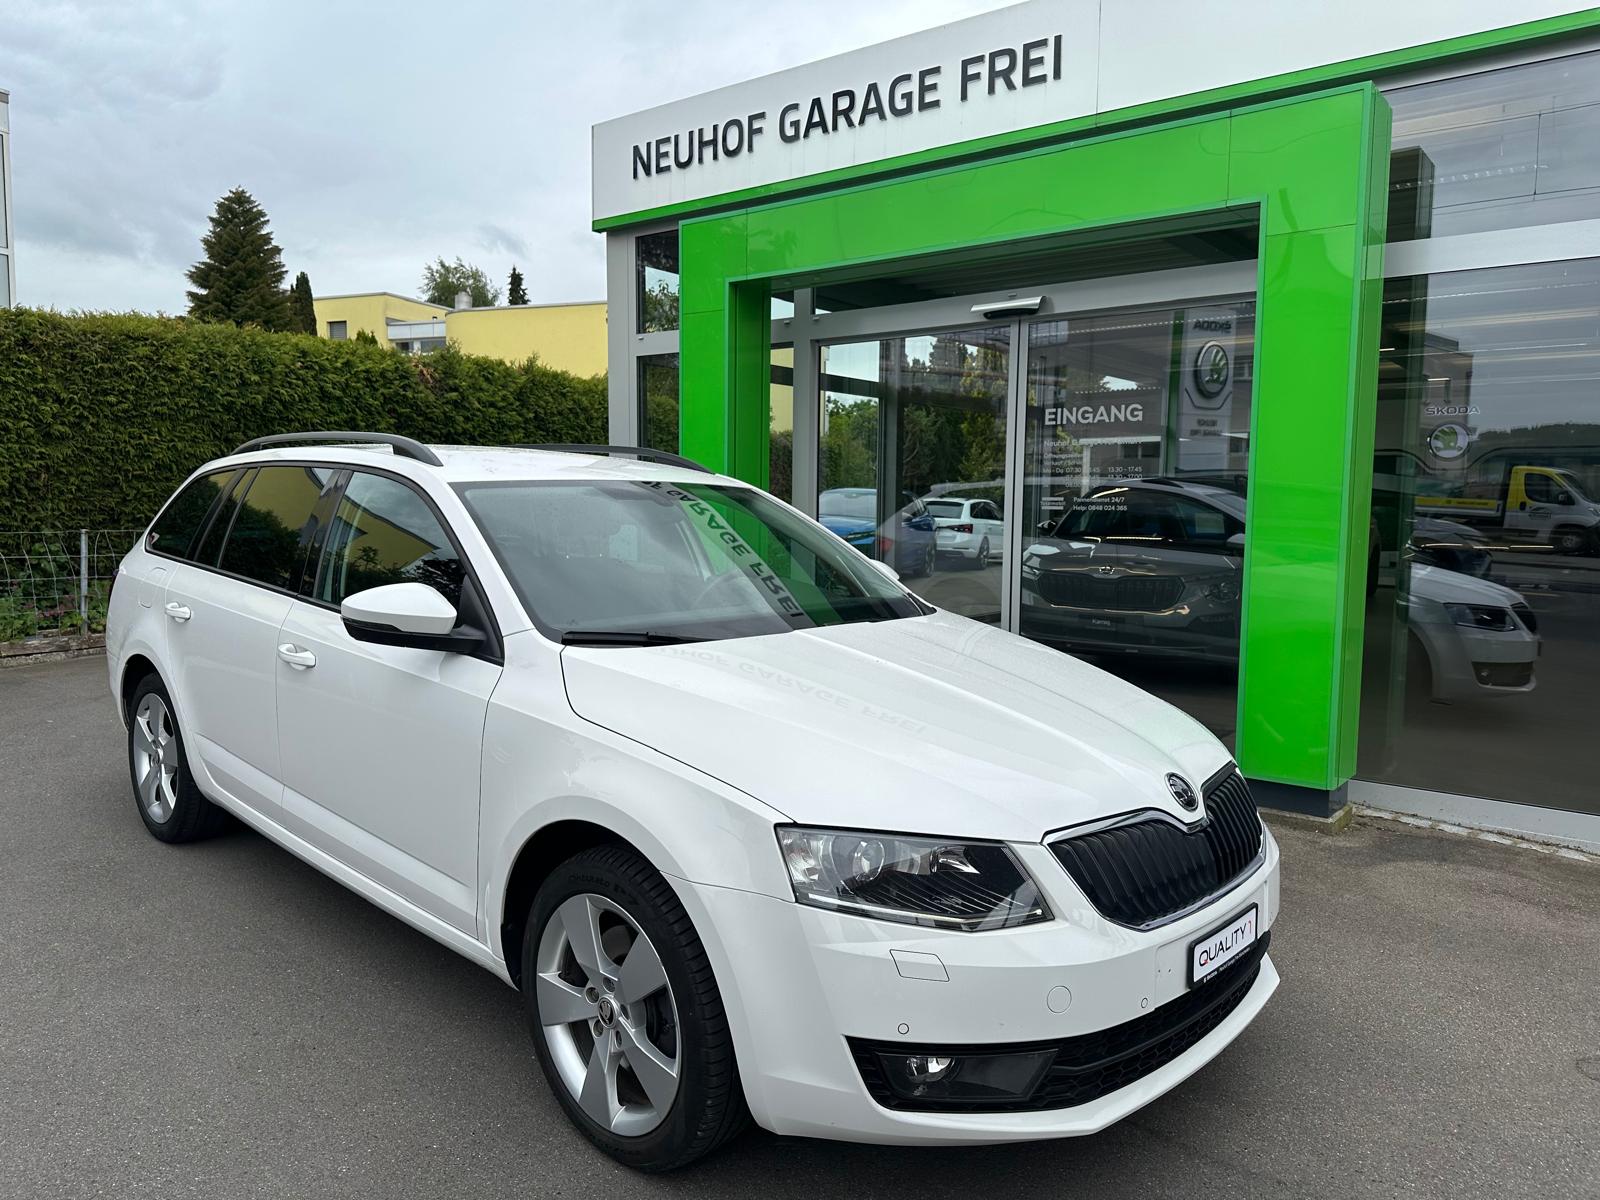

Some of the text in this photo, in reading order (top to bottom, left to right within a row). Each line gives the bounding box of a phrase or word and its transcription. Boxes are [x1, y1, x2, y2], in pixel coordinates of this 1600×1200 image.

[632, 34, 1063, 180] NEUHOF GARAGE FREI
[1044, 404, 1144, 425] EINGANG
[1199, 923, 1247, 967] QUALITY
